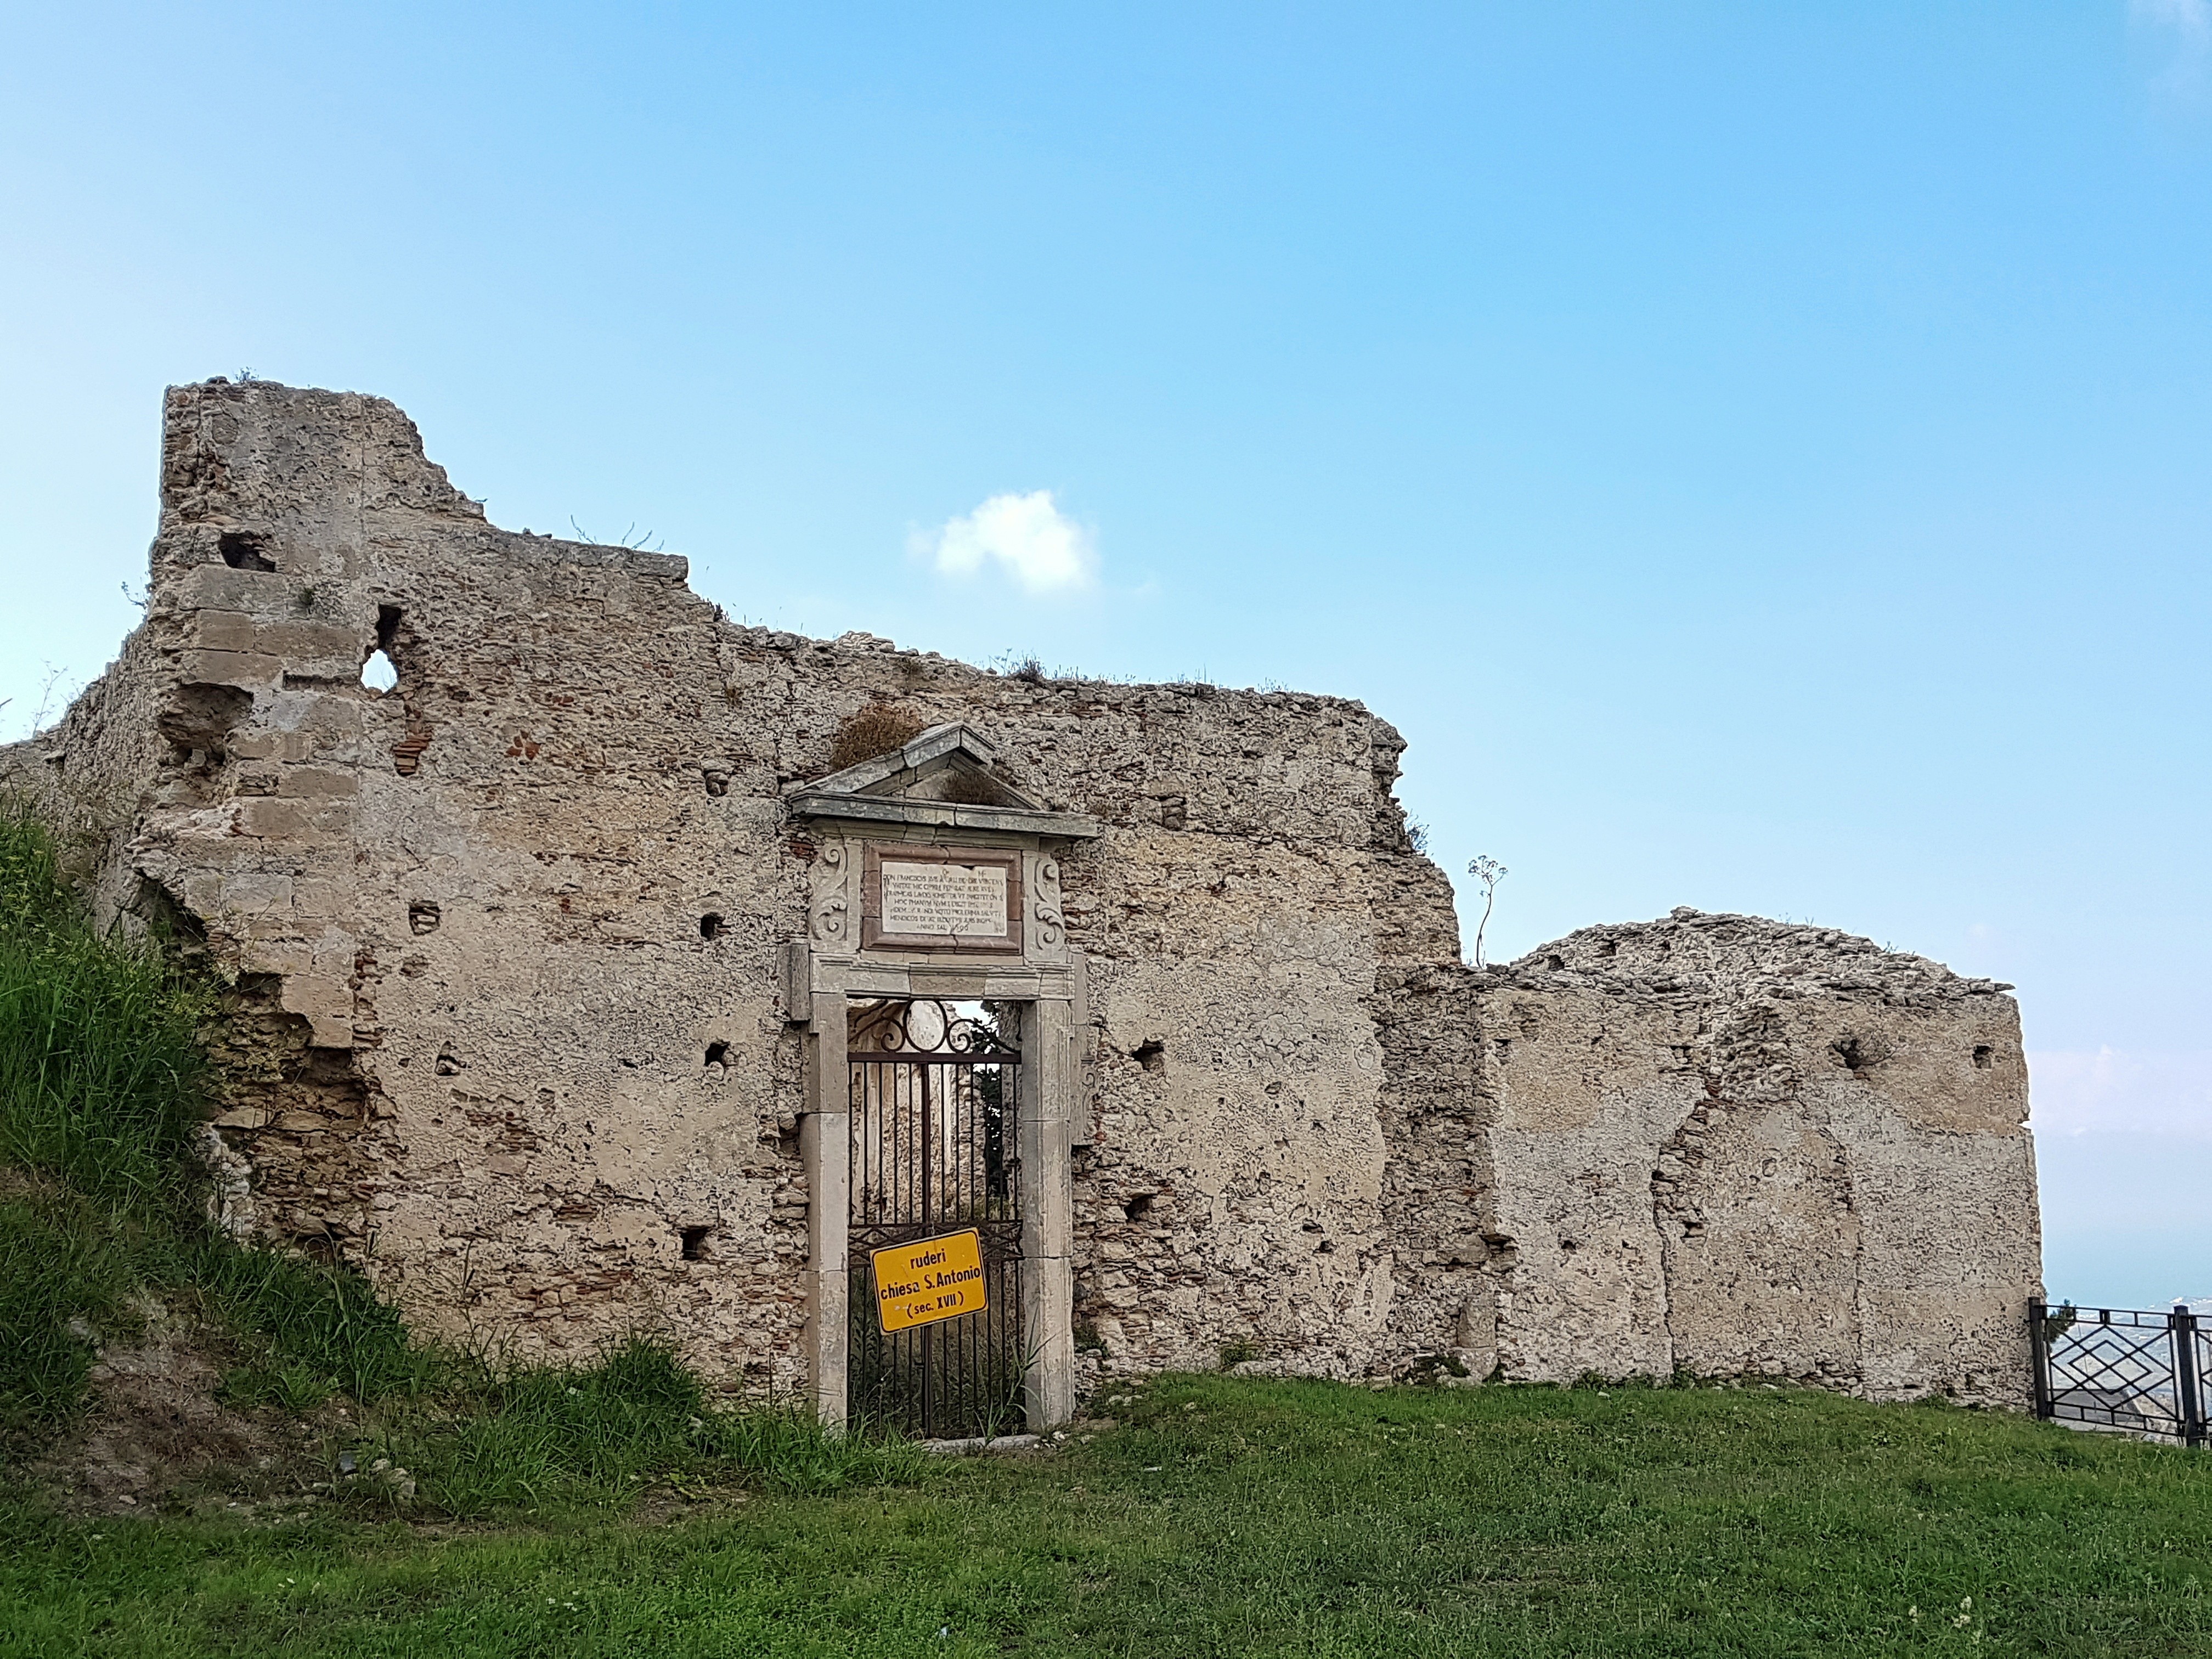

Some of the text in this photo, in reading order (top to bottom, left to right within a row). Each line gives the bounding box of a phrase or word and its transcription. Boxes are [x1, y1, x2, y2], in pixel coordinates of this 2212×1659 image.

[910, 1248, 946, 1269] ruderi
[881, 1266, 981, 1300] chiesa S.Antonio
[907, 1290, 964, 1319] (sec. XVII)
